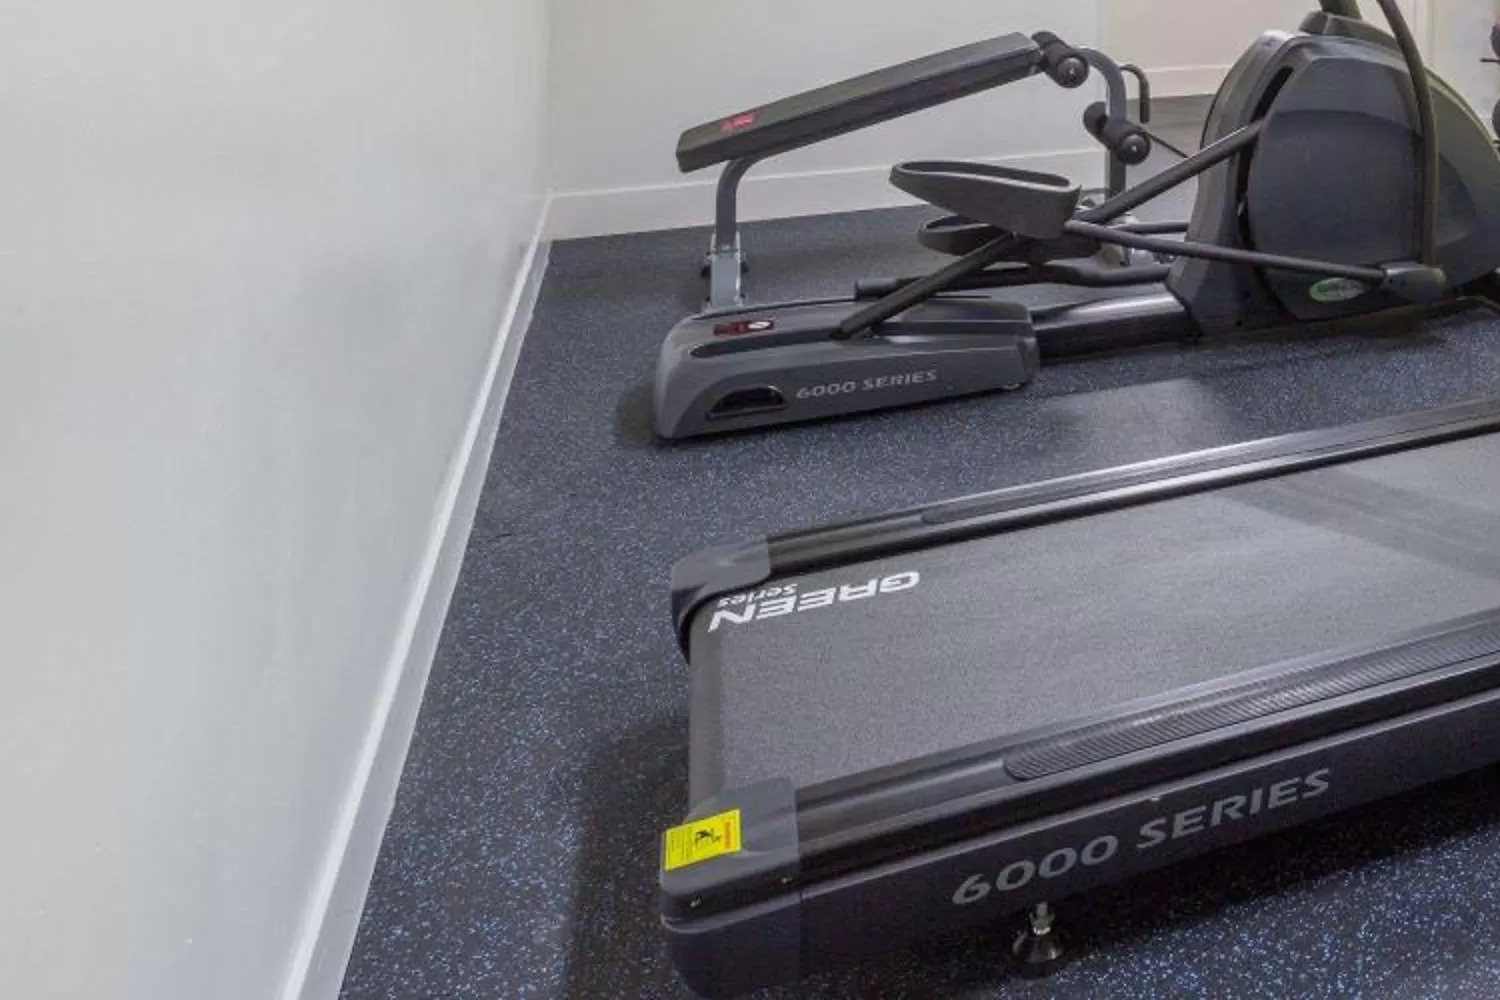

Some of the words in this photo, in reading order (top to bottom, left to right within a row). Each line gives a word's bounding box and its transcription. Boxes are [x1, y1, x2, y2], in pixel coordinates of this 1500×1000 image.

[796, 380, 857, 400] 6000
[862, 369, 937, 391] SERIES
[708, 571, 920, 633] GREEN
[951, 834, 1120, 905] 6000
[1136, 767, 1330, 850] SERIES
